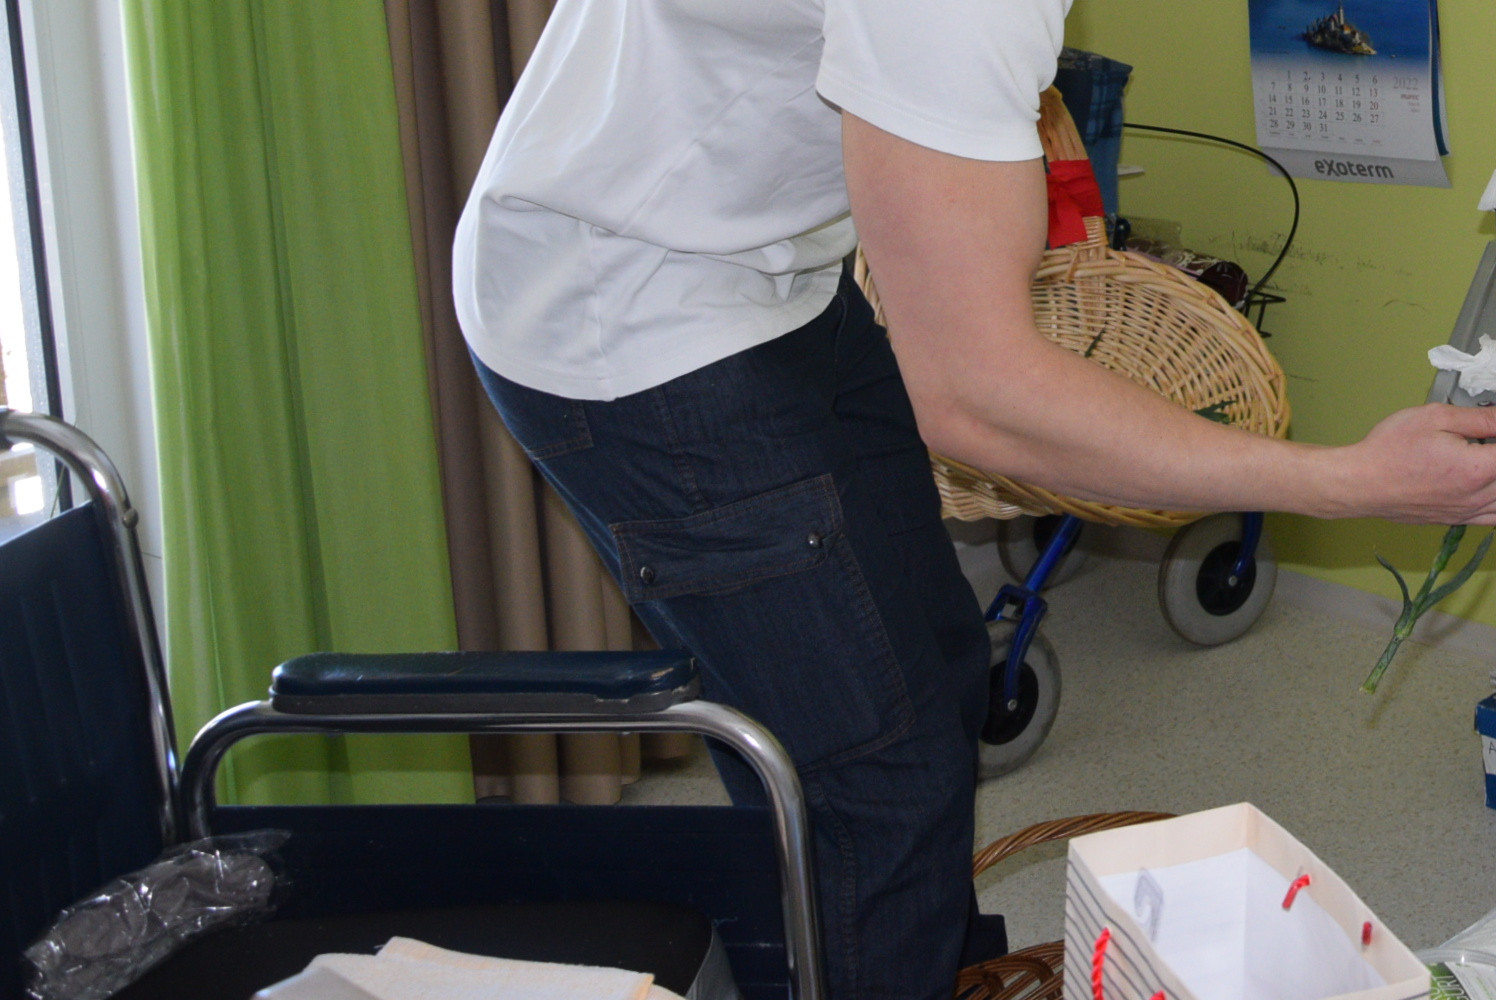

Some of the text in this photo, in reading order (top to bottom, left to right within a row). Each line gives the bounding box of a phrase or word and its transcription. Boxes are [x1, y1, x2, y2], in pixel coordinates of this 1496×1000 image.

[1318, 85, 1326, 94] 10
[1335, 86, 1342, 95] 11
[1352, 87, 1360, 96] 12
[1370, 88, 1378, 97] 13
[1269, 94, 1378, 110] 14 15 16 17 18 19 20
[1268, 106, 1379, 123] 21 22 23 24 25 26 27
[1269, 119, 1328, 132] 28 29 30 31
